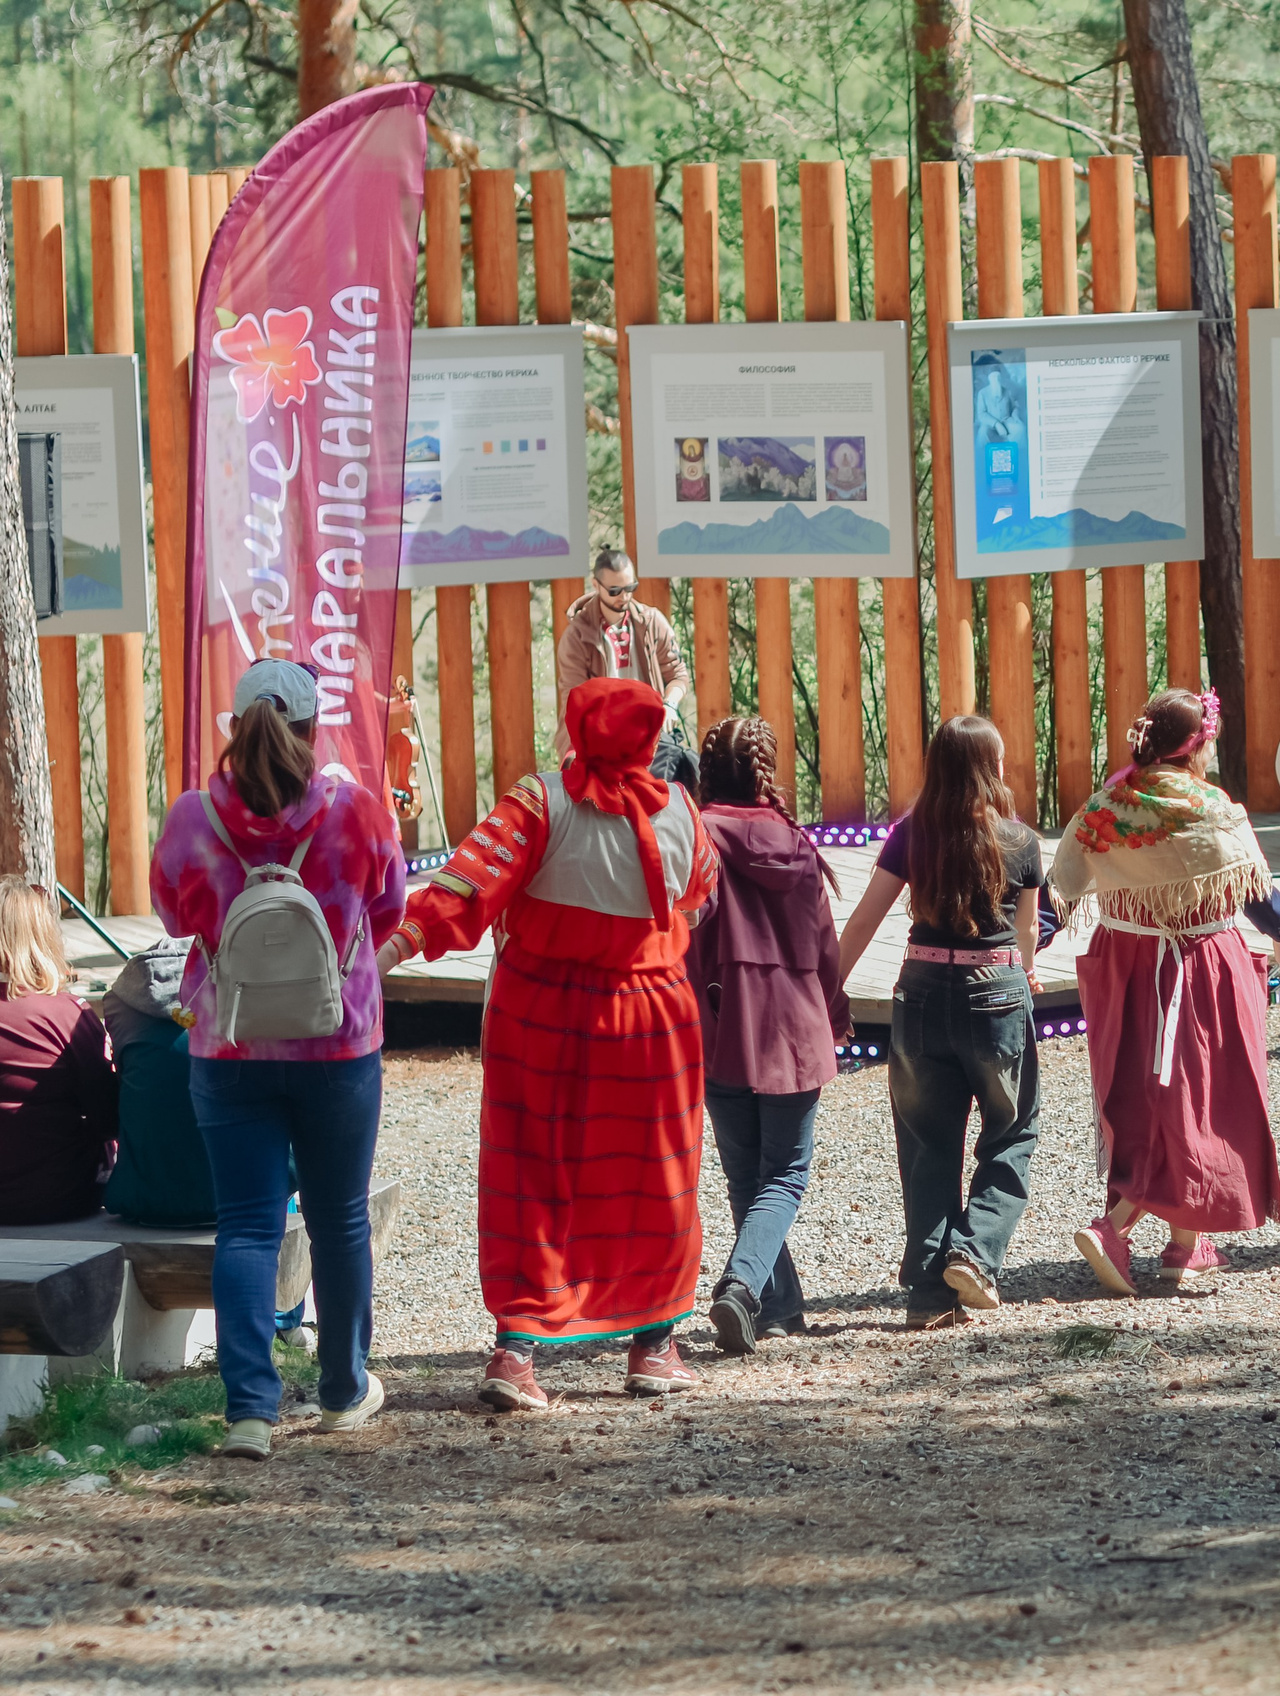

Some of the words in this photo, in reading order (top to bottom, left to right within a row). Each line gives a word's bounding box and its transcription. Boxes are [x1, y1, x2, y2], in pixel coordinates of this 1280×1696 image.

[1048, 356, 1097, 368] НЕСКОЛЬКО
[1098, 354, 1132, 366] ФАКТОВ
[1132, 355, 1139, 364] О
[1140, 353, 1171, 363] РЕРИХЕ
[410, 371, 446, 382] ВЕННОЕ
[447, 370, 503, 381] ТВОРЧЕСТВО
[505, 369, 539, 378] РЕРИХА
[738, 365, 796, 374] ФИЛОСОФИЯ
[24, 403, 57, 414] АЛТАЕ
[309, 283, 379, 727] МАРАЛЬНИКА
